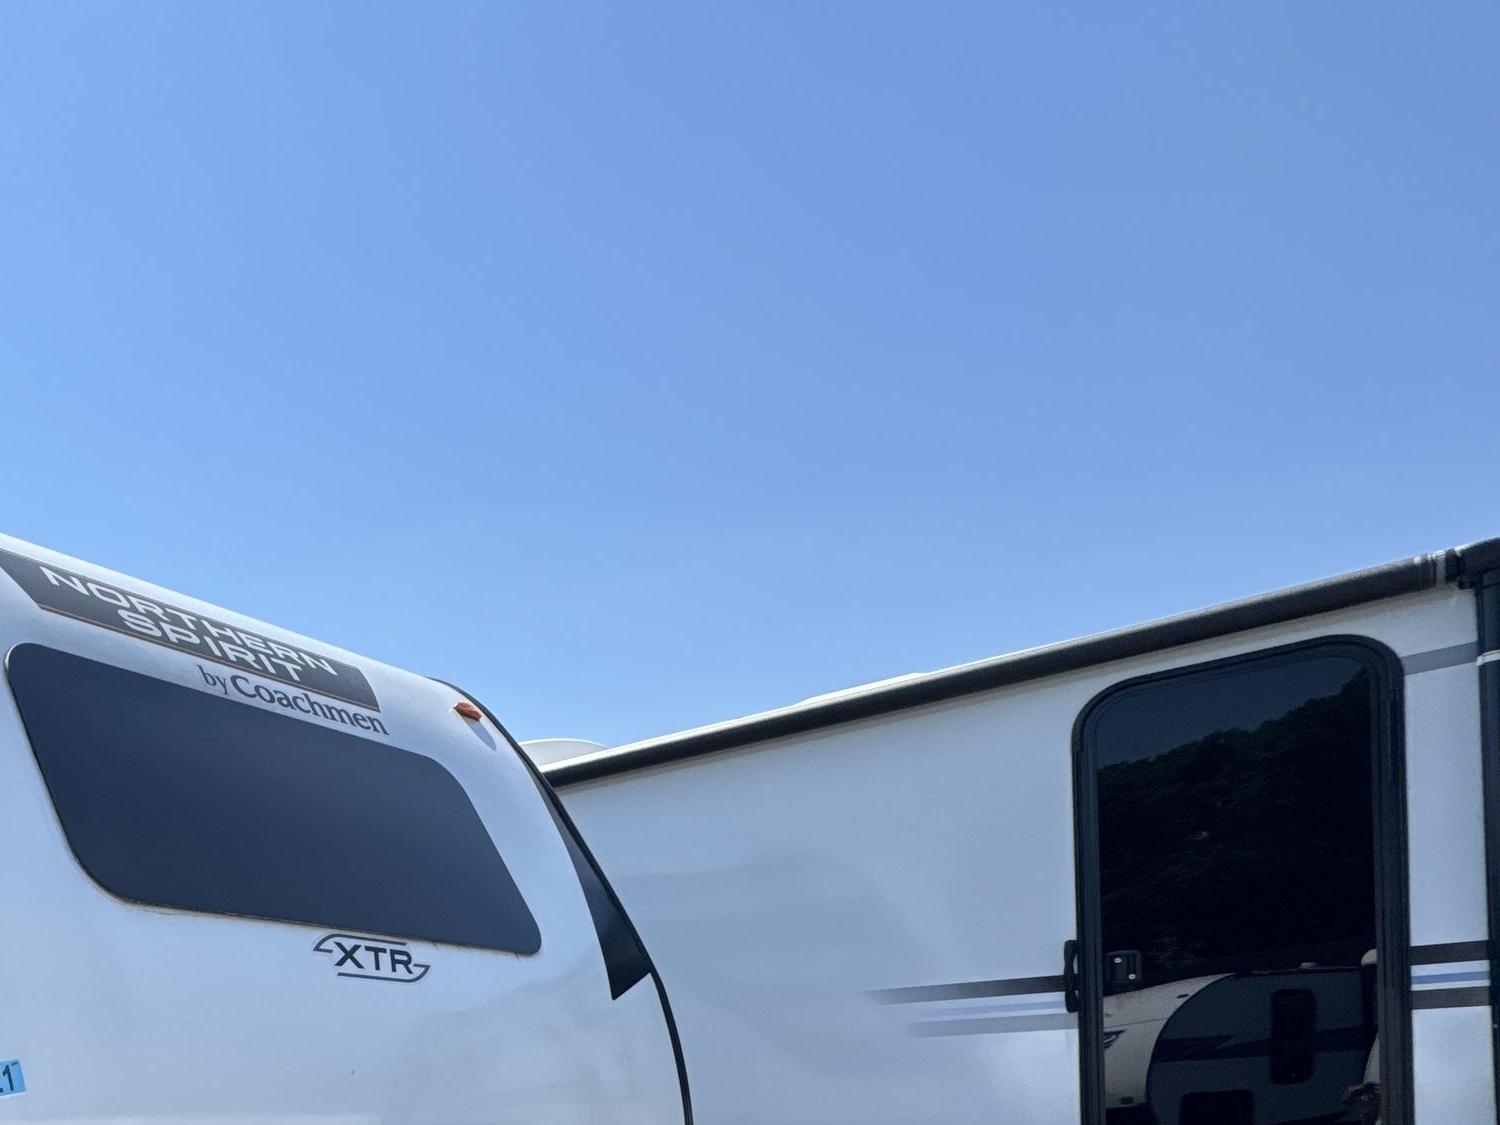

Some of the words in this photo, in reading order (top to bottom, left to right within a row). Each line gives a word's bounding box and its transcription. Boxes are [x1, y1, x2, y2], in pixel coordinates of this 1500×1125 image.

[38, 565, 338, 676] NORTHERN
[117, 608, 301, 682] SPIRIT
[197, 664, 230, 696] by
[230, 674, 390, 736] Coachmen
[333, 941, 414, 975] XTR
